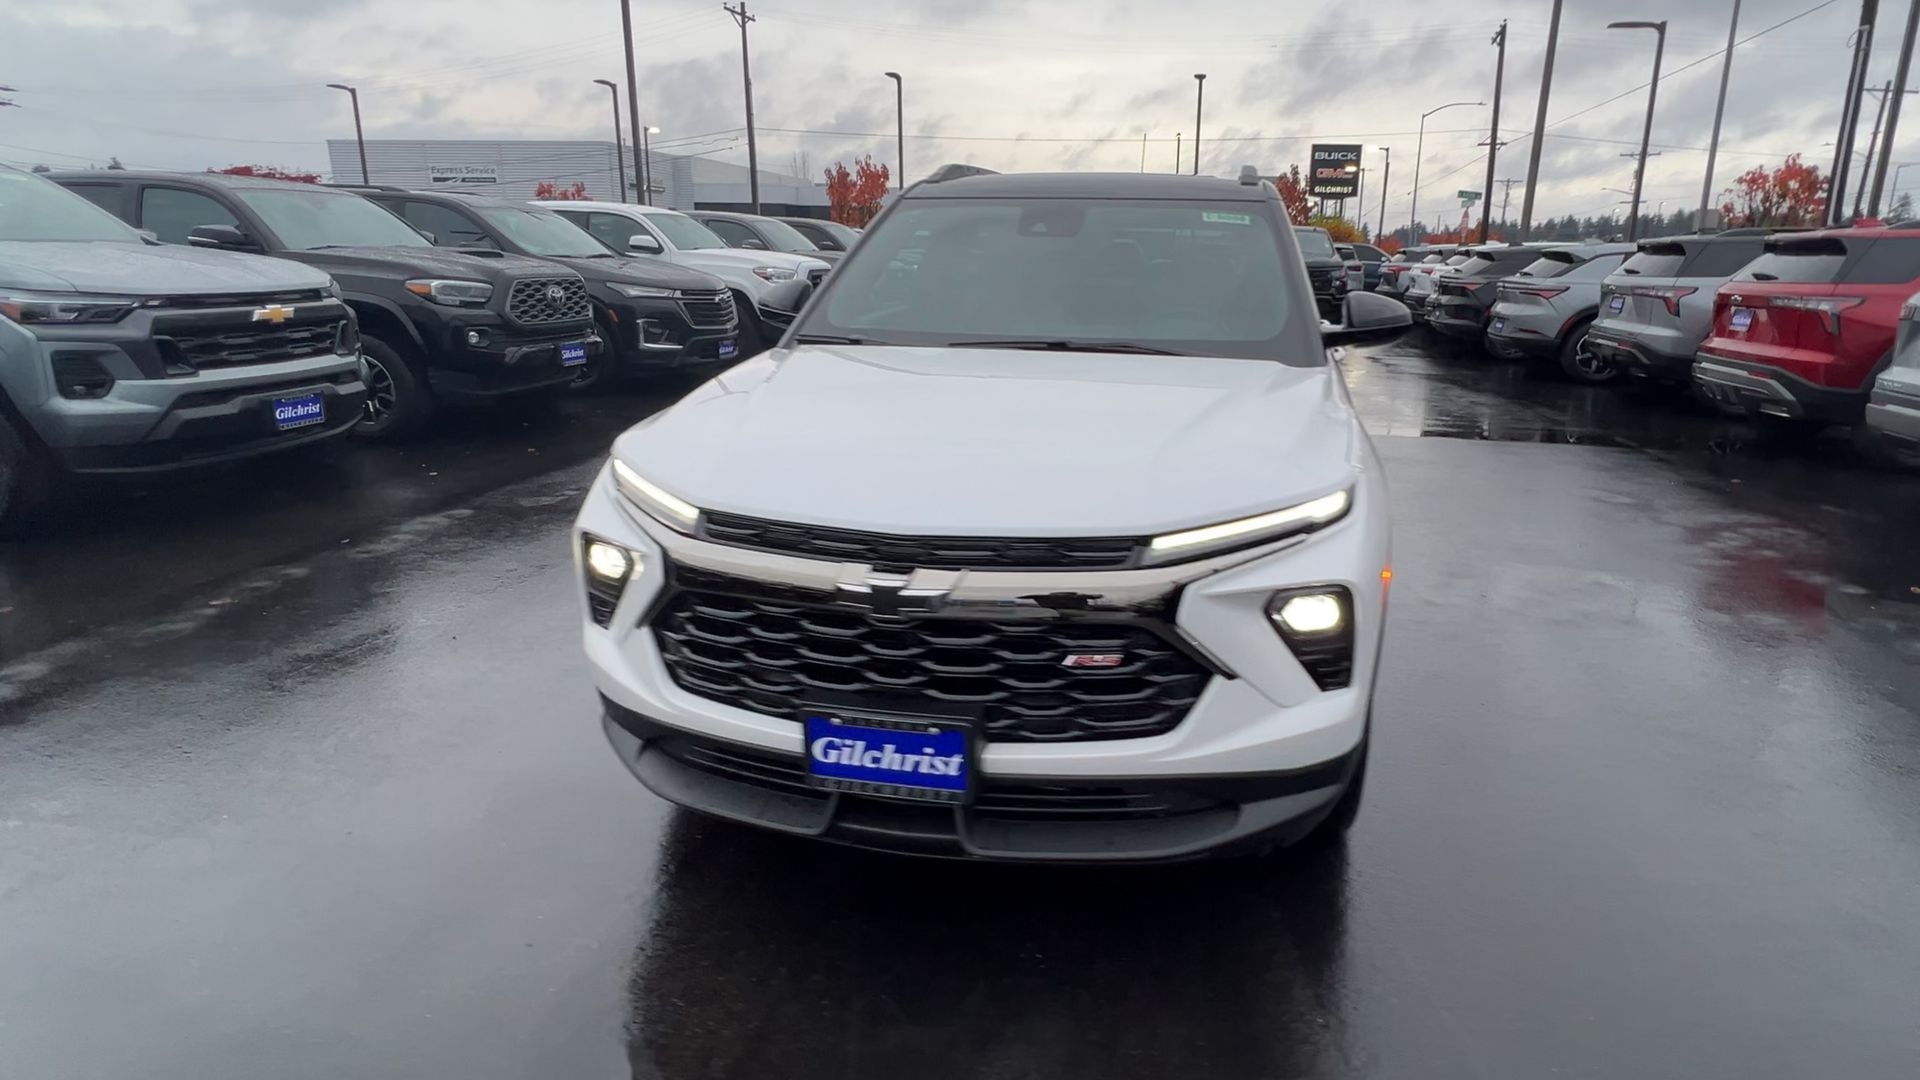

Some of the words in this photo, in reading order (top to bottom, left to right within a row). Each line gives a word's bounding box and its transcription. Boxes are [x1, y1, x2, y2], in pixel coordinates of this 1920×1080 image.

[1314, 151, 1357, 160] BUICK
[431, 166, 463, 175] Express
[465, 166, 496, 174] Service
[275, 402, 320, 420] Gilchrist
[811, 736, 964, 776] Gilchrist
